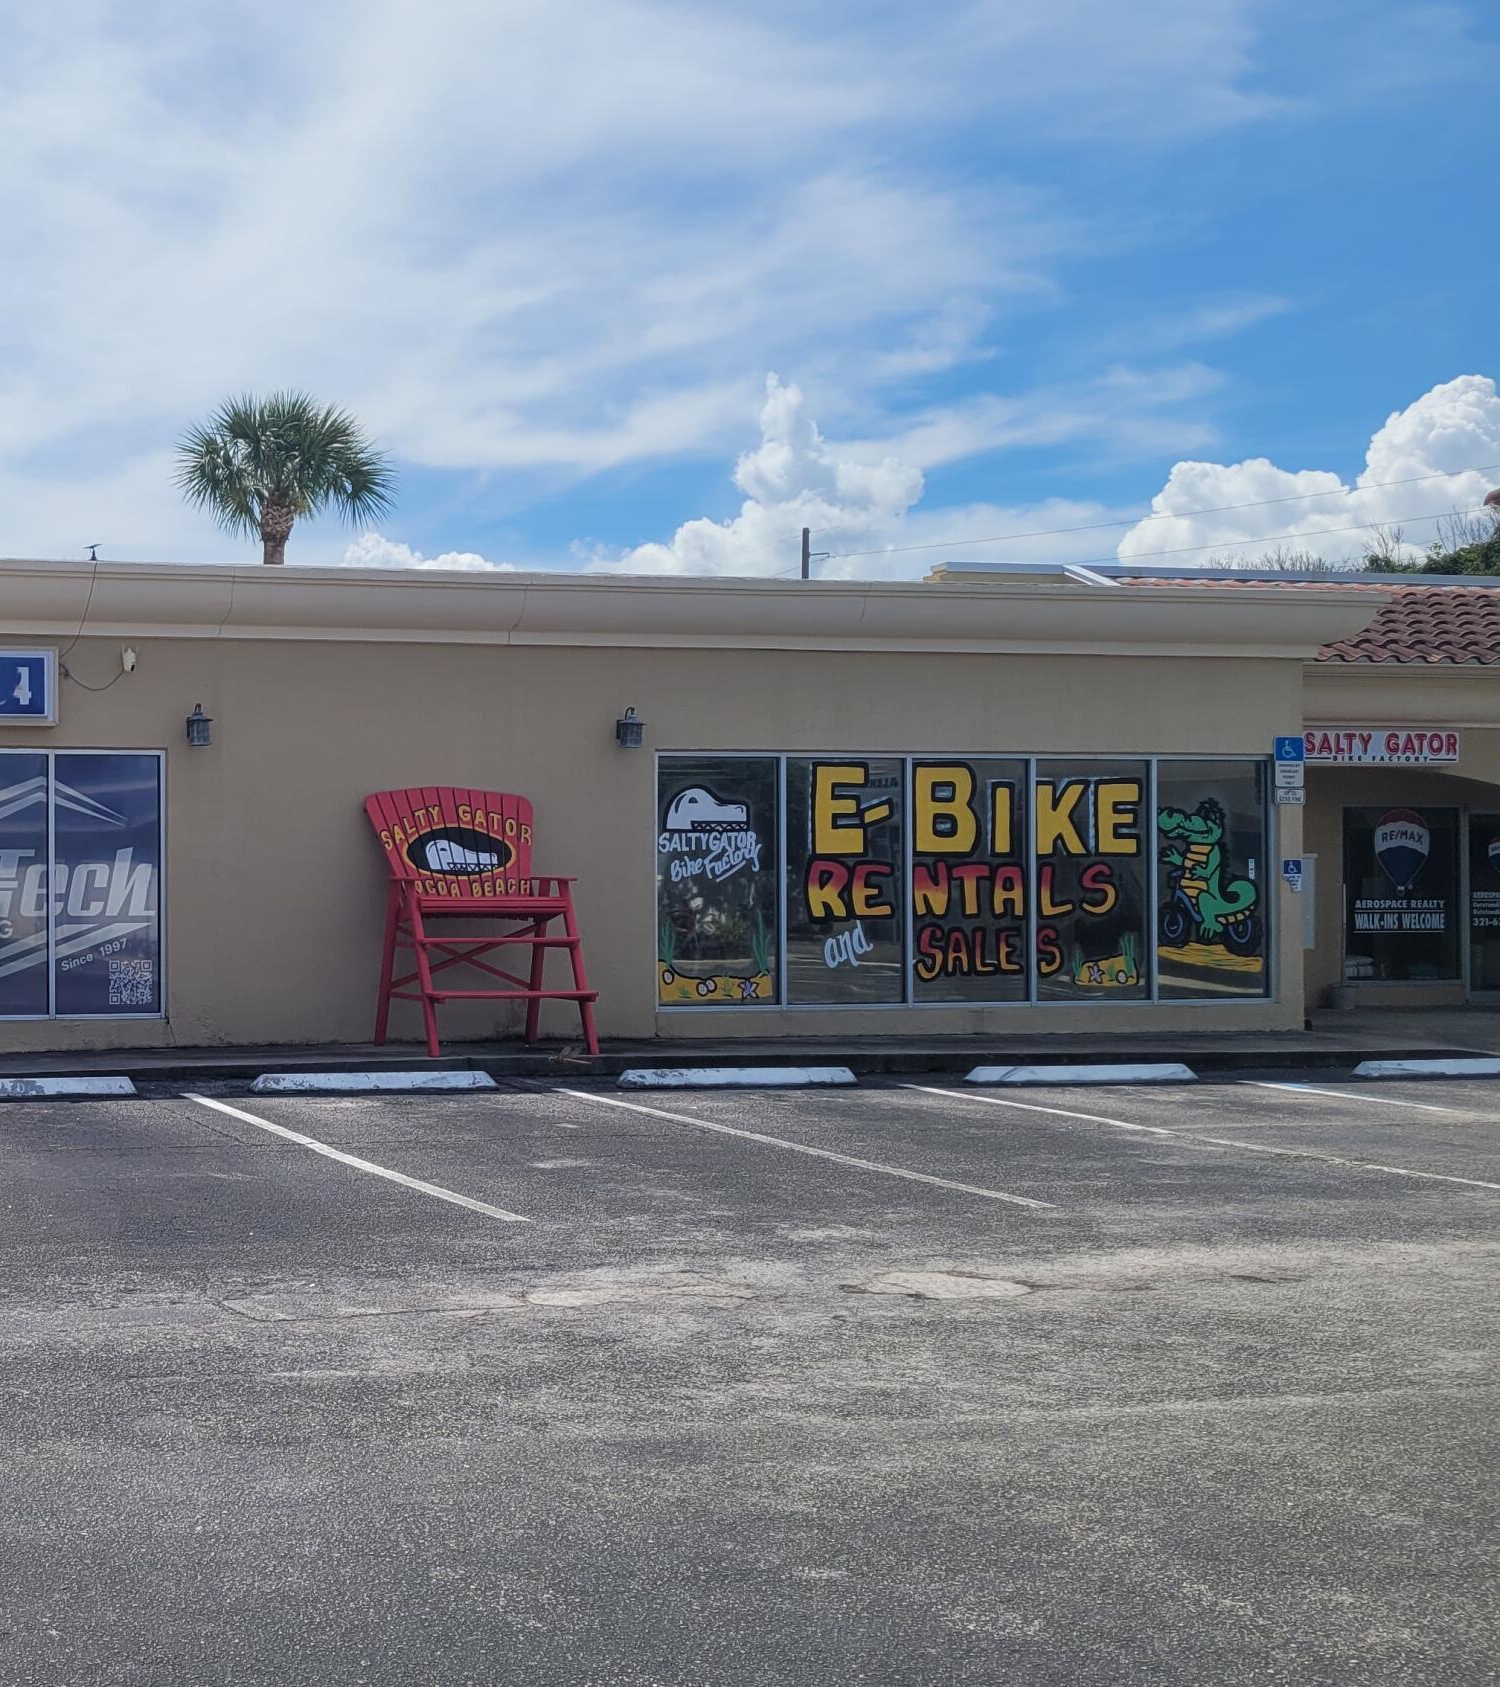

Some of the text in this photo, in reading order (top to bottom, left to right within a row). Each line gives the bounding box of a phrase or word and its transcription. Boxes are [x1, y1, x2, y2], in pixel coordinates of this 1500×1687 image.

[1304, 732, 1458, 757] SALTY GATOR
[380, 803, 533, 850] SALTY GATOR
[1381, 829, 1424, 846] RE/MAX
[670, 844, 762, 882] Bike Factory
[414, 878, 531, 898] OCOA BEACH
[804, 859, 1118, 922] RENTALS
[1354, 899, 1445, 909] AEROSPACE REALTY
[1354, 912, 1445, 930] WALK-INS WELCOME
[60, 937, 128, 972] Since 1997
[824, 920, 1063, 982] and SALES
